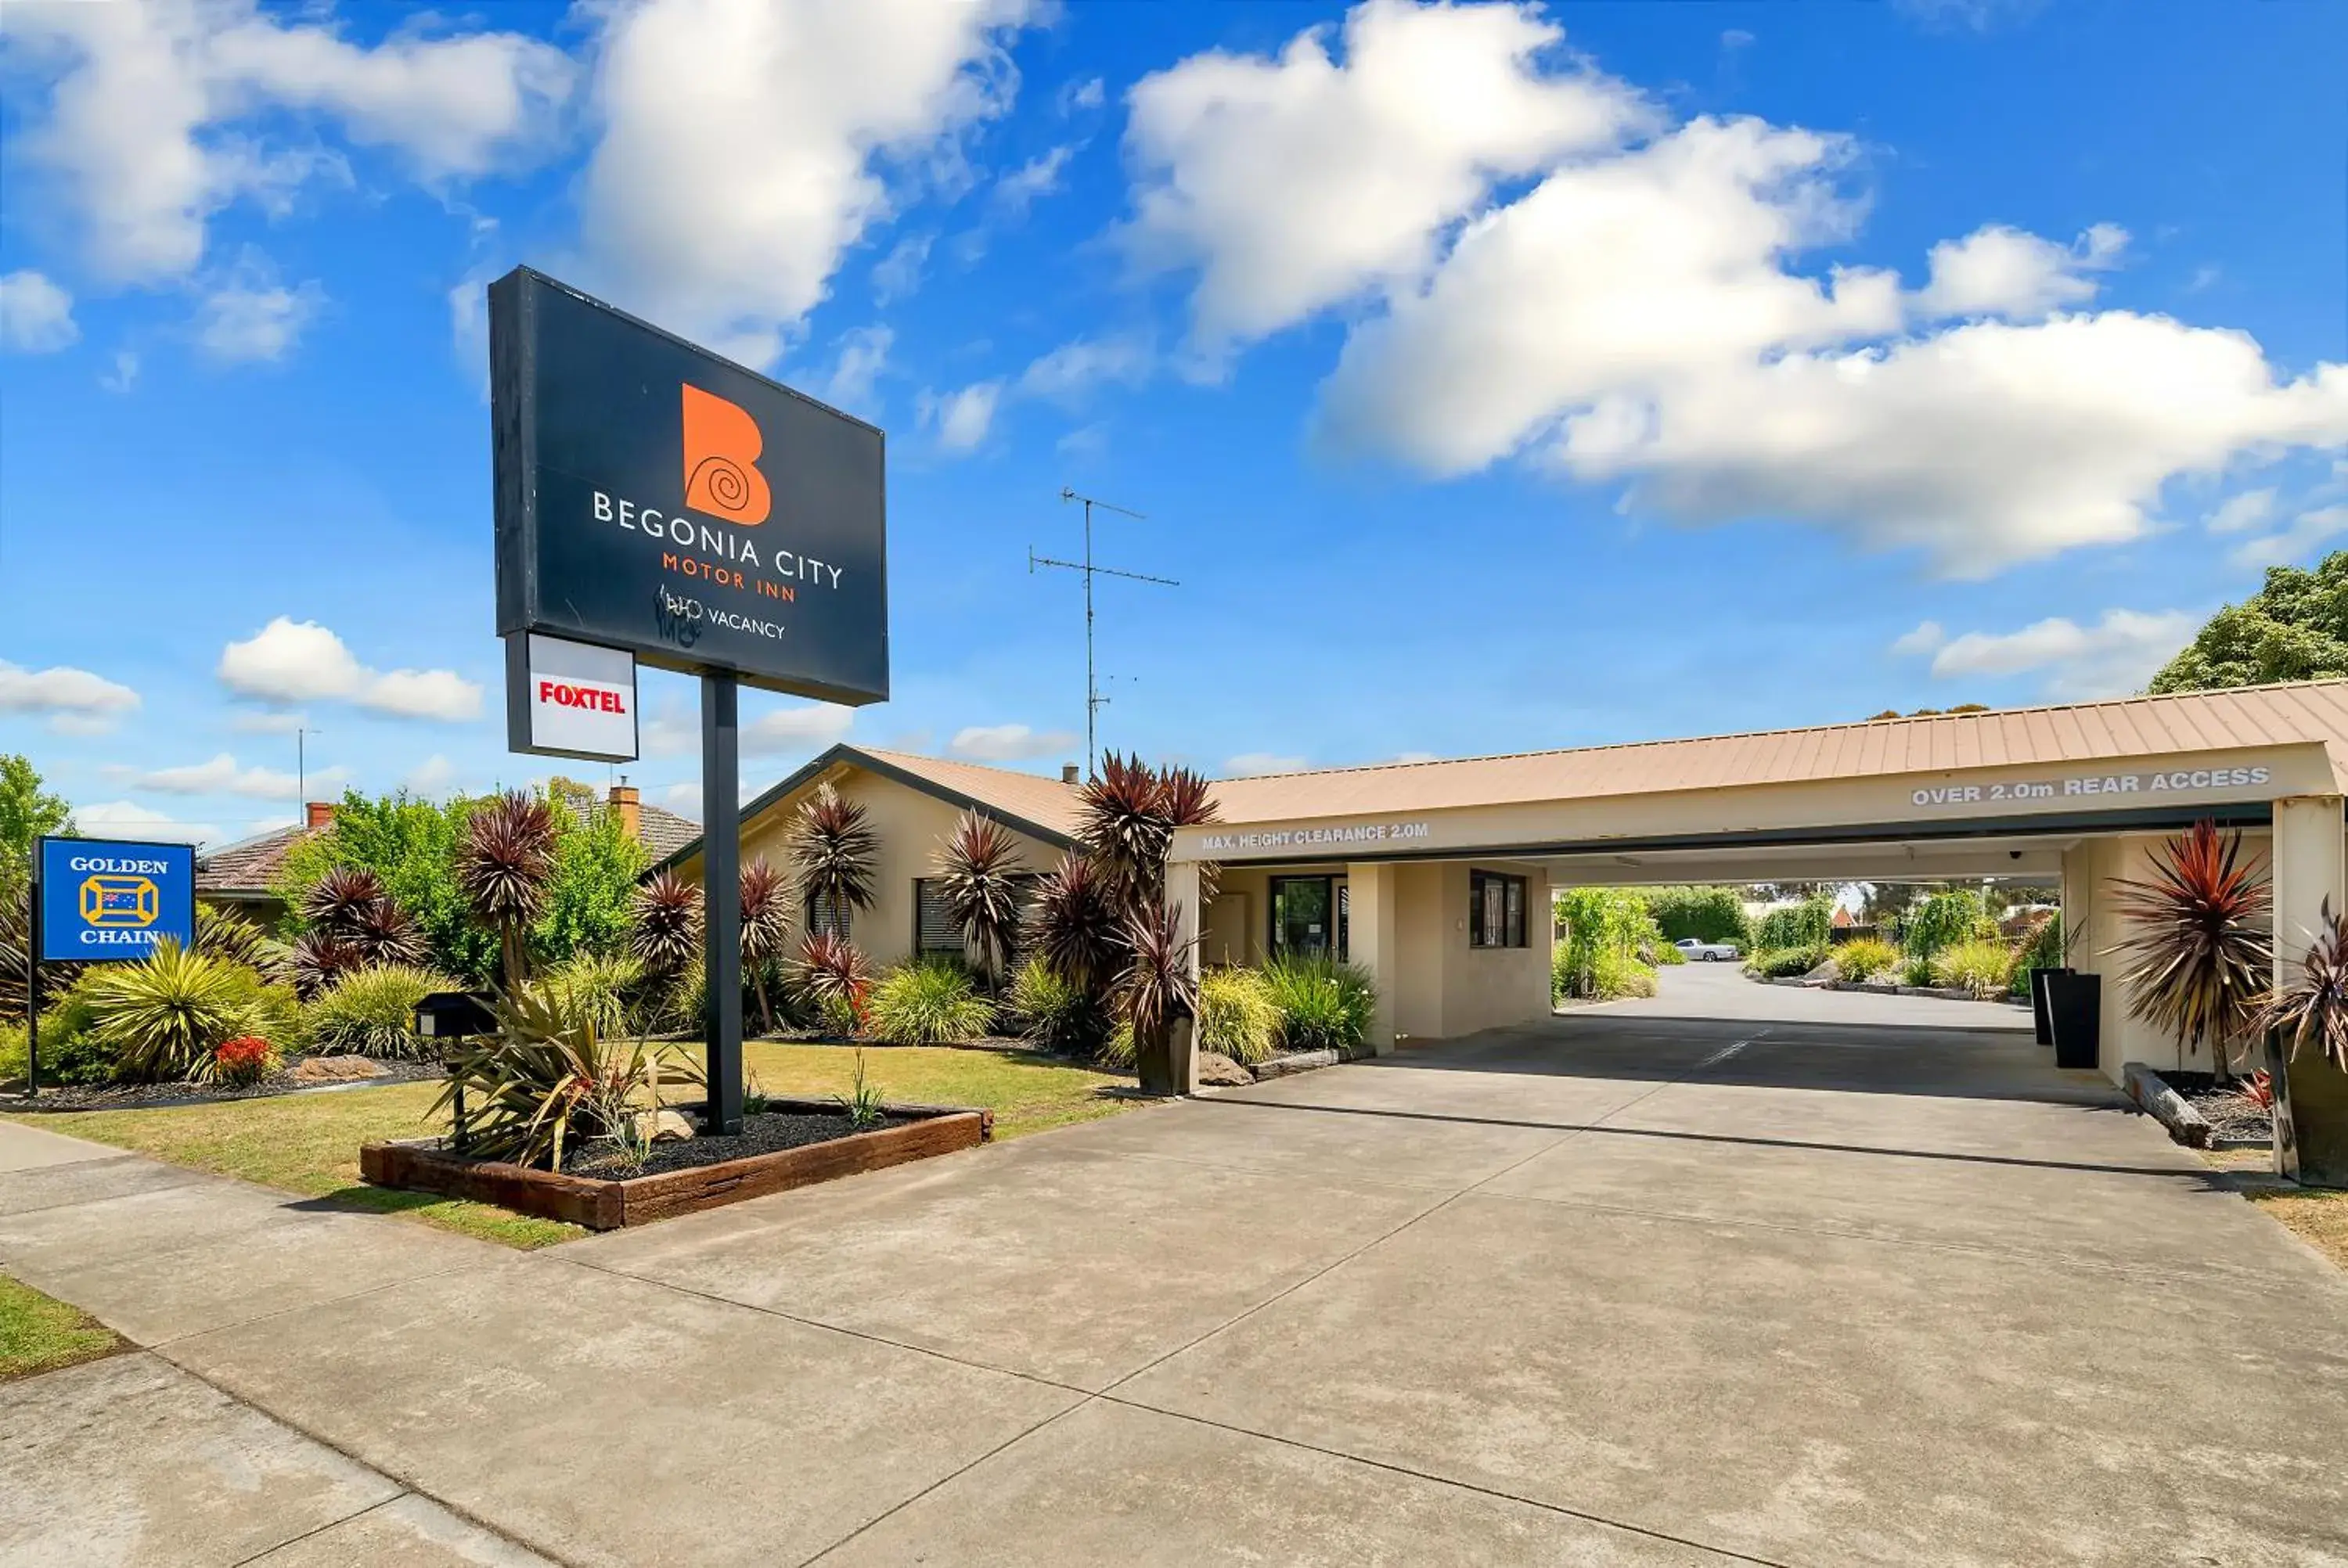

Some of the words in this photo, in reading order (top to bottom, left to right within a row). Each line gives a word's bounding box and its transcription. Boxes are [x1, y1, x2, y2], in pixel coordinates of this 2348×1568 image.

[593, 490, 760, 568] BEGONIA
[775, 550, 844, 589] CITY
[662, 552, 744, 589] MOTOR
[757, 580, 795, 603] INN
[708, 607, 785, 639] VACANCY
[539, 682, 626, 714] FOXTEL
[1913, 786, 1980, 806] OVER
[1990, 782, 2054, 800] 2.0m
[2065, 775, 2140, 795] REAR
[2151, 766, 2270, 790] ACCESS
[1202, 836, 1236, 851] MAX.
[1239, 832, 1291, 847] HEIGHT
[1295, 825, 1387, 844] CLEARANCE
[1391, 823, 1428, 839] 2.0M
[70, 857, 169, 874] GOLDEN
[80, 930, 162, 944] CHAIN
